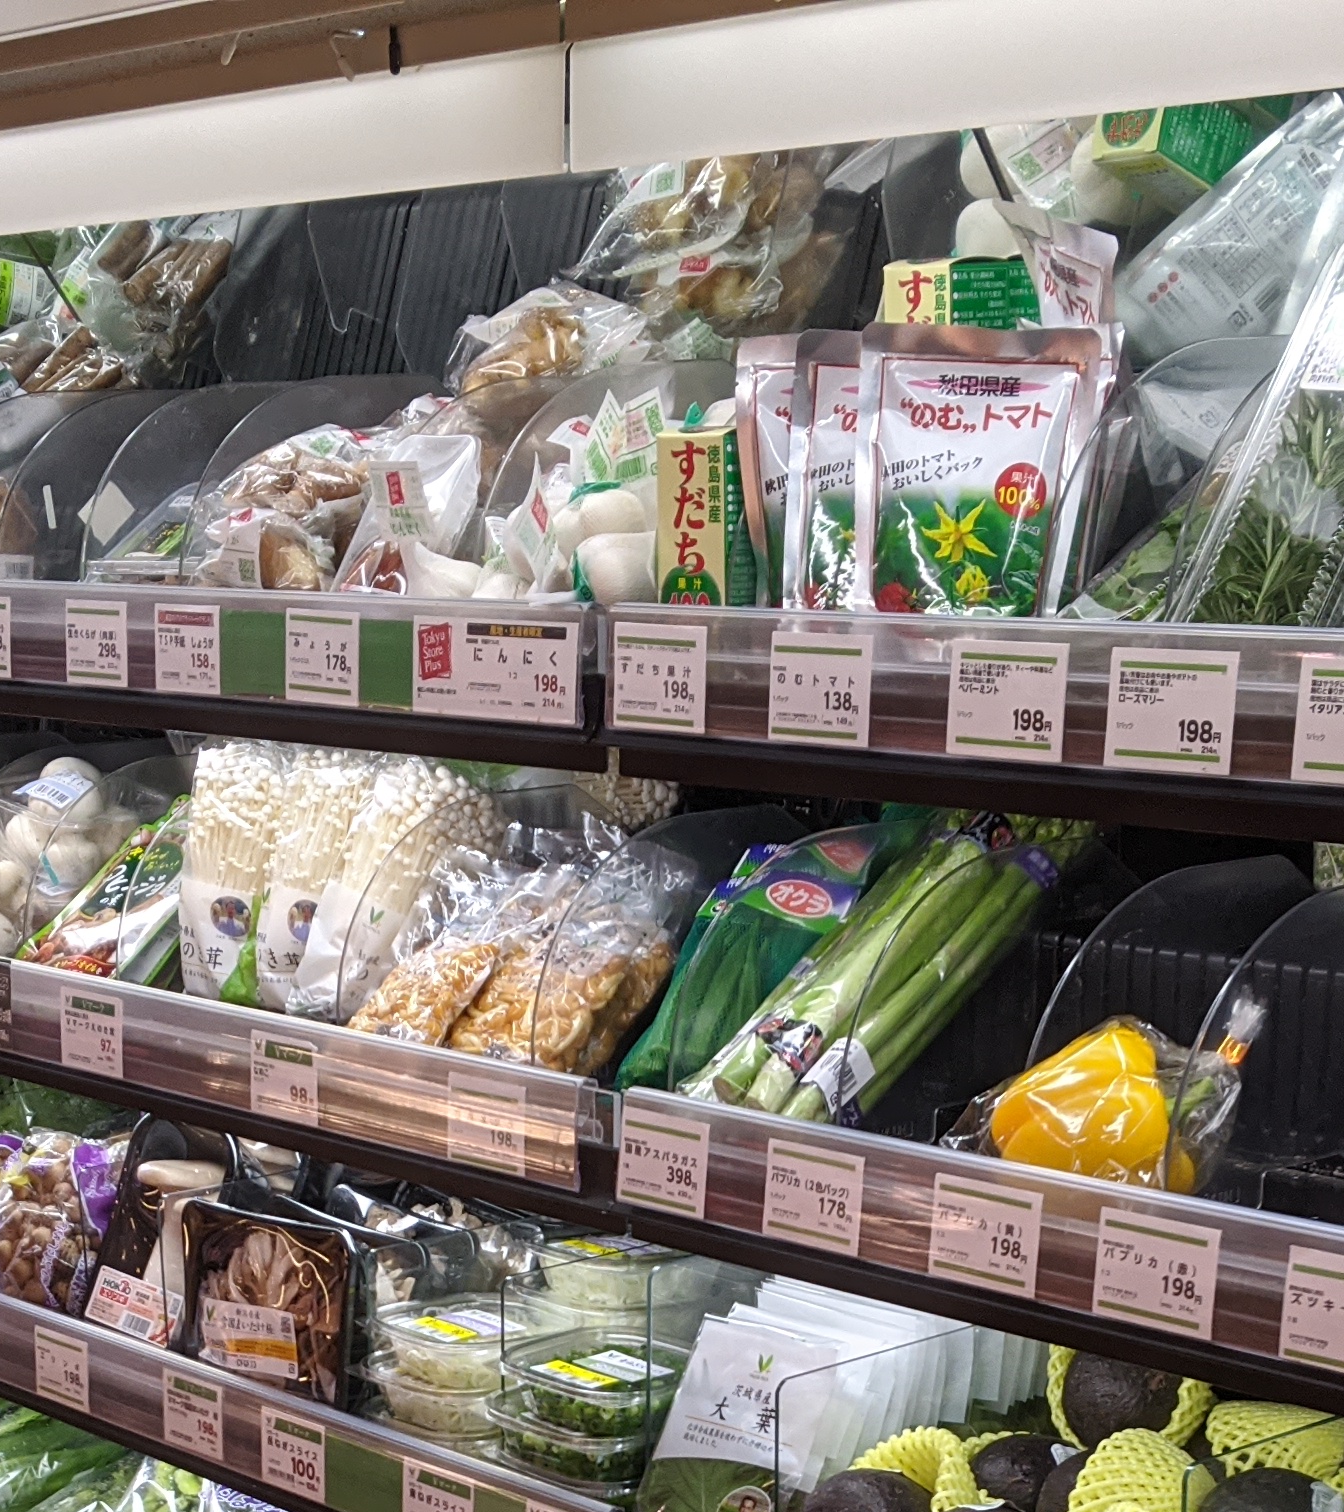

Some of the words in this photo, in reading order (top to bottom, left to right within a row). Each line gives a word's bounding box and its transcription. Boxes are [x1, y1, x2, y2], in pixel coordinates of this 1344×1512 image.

[937, 374, 1021, 398] 秋田県産
[707, 445, 721, 523] 徳島県産
[892, 457, 983, 491] おいしくパック
[1011, 471, 1036, 482] 果汁
[671, 441, 706, 574] すだち
[677, 576, 702, 590] 果汁
[97, 642, 121, 660] 298円
[292, 636, 348, 652] みょうが
[190, 652, 216, 669] 158円
[325, 653, 351, 675] 178円
[472, 646, 559, 667] にんにく
[533, 673, 566, 695] 198円
[662, 680, 695, 702] 198円
[776, 672, 856, 689] のむトマト
[958, 683, 1000, 695] ペパーミント
[823, 690, 859, 715] 138円
[1118, 693, 1164, 704] ローズマリー
[1013, 708, 1052, 732] 198円
[1178, 719, 1221, 745] 198円
[624, 1142, 698, 1169] 国産アスパラガス
[665, 1166, 698, 1191] 398円
[818, 1196, 853, 1224] 178円
[990, 1235, 1028, 1264] 198円
[1160, 1274, 1203, 1305] 198円
[732, 1383, 775, 1406] 茨城県産
[291, 1455, 321, 1484] 100円
